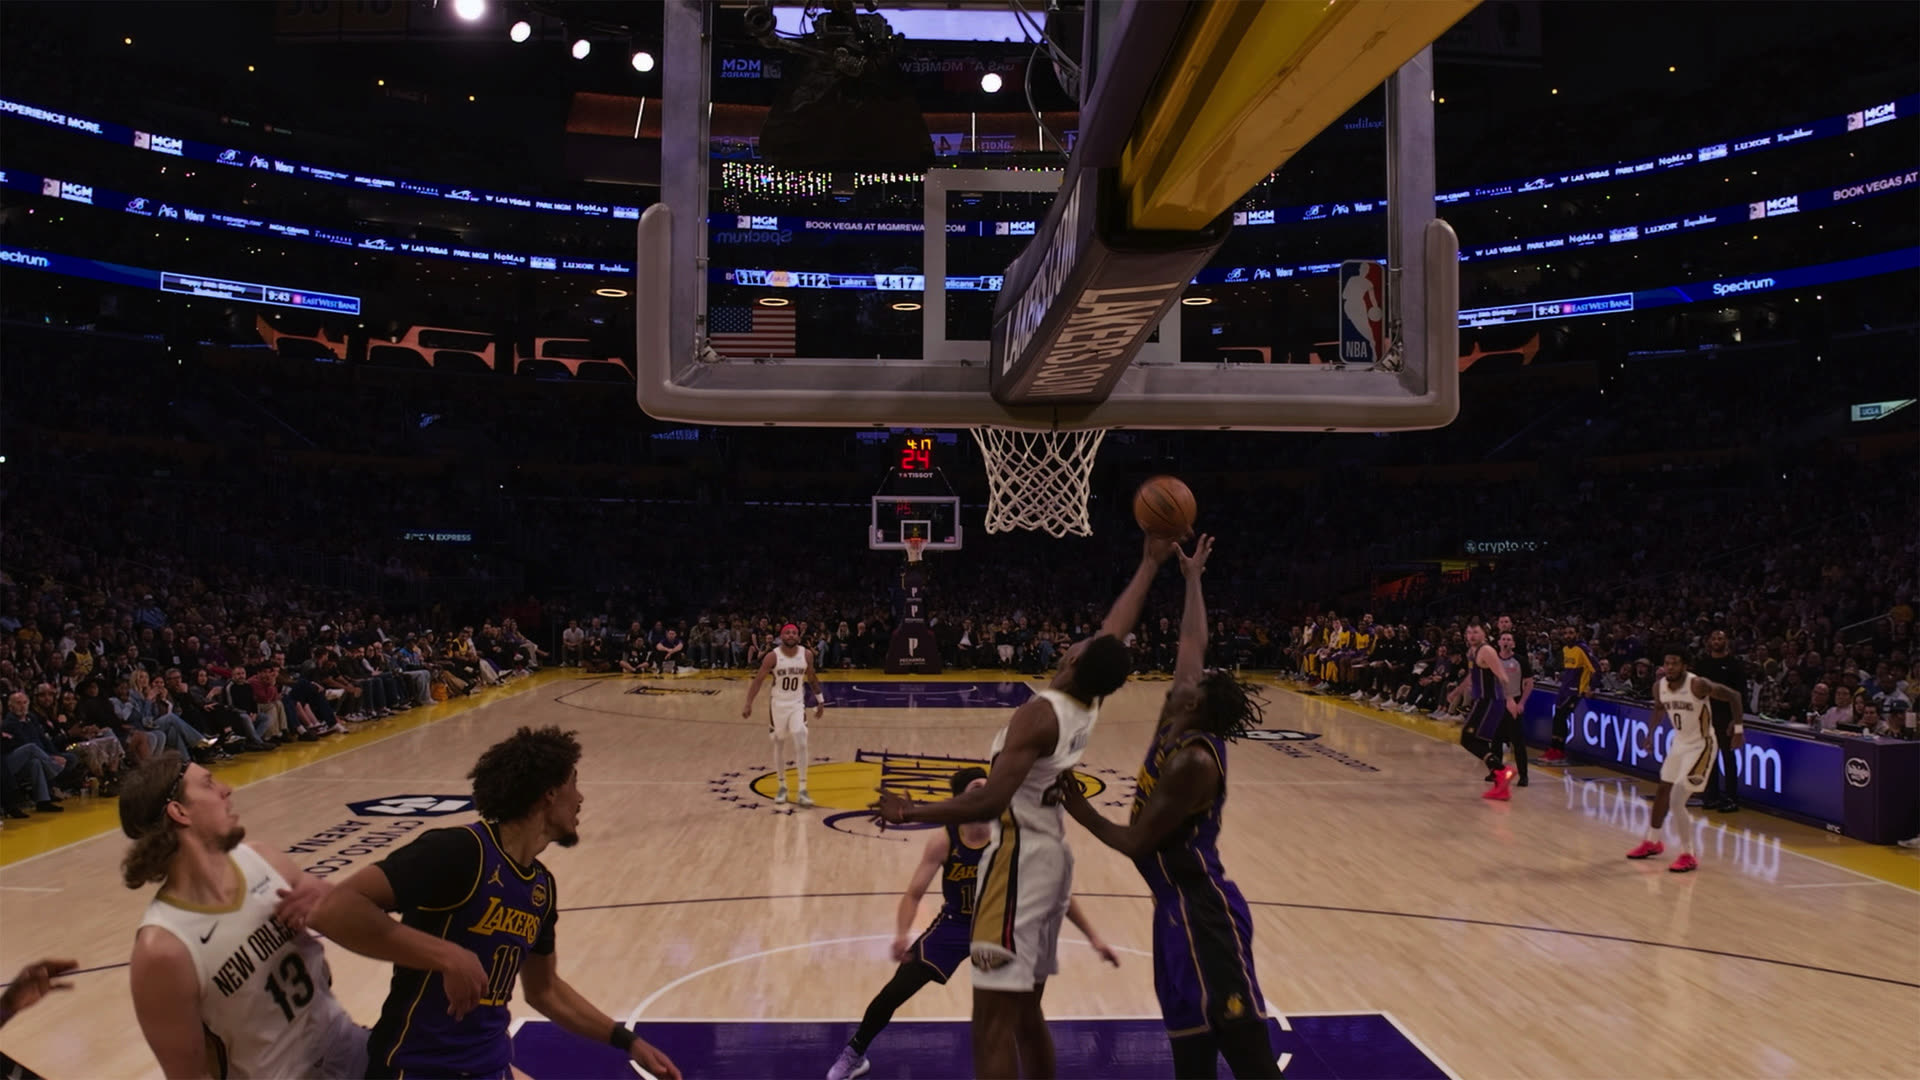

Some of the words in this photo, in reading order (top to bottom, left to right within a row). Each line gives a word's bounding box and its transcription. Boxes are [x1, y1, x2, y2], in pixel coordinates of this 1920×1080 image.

[0, 99, 66, 127] EXPERIENCE
[1864, 102, 1896, 121] MGM
[151, 133, 184, 150] MGM
[61, 181, 93, 198] MGM
[1833, 184, 1864, 201] BOOK
[1865, 177, 1903, 194] VEGAS
[1903, 171, 1919, 185] AT
[1767, 195, 1798, 210] MGM
[752, 216, 778, 225] MGM
[1248, 209, 1275, 220] MGM
[805, 220, 831, 230] BOOK
[832, 221, 863, 231] VEGAS
[863, 222, 876, 231] AT
[1009, 221, 1035, 230] MGM
[0, 250, 49, 268] ectrum
[882, 276, 915, 288] 4:17
[945, 279, 975, 288] elicans
[1002, 173, 1082, 377] LAKERS.COM
[1713, 277, 1774, 296] Spectrum
[268, 290, 290, 302] 9:43
[1538, 304, 1560, 316] 9:43
[1027, 281, 1181, 397] LAKERS.COM
[1345, 340, 1369, 359] NBA
[906, 439, 932, 451] 4:17
[901, 450, 930, 470] 24
[908, 471, 934, 479] TISSOT
[436, 533, 472, 542] EXPRESS
[782, 676, 799, 691] 00
[1674, 713, 1682, 731] 0
[1583, 709, 1783, 795] cryptom
[303, 819, 424, 880] CRYPTO.CO
[944, 862, 979, 882] LAK
[467, 896, 542, 945] LAKERS
[213, 945, 256, 998] NEW
[480, 944, 522, 1006] 11
[264, 952, 315, 1023] 13
